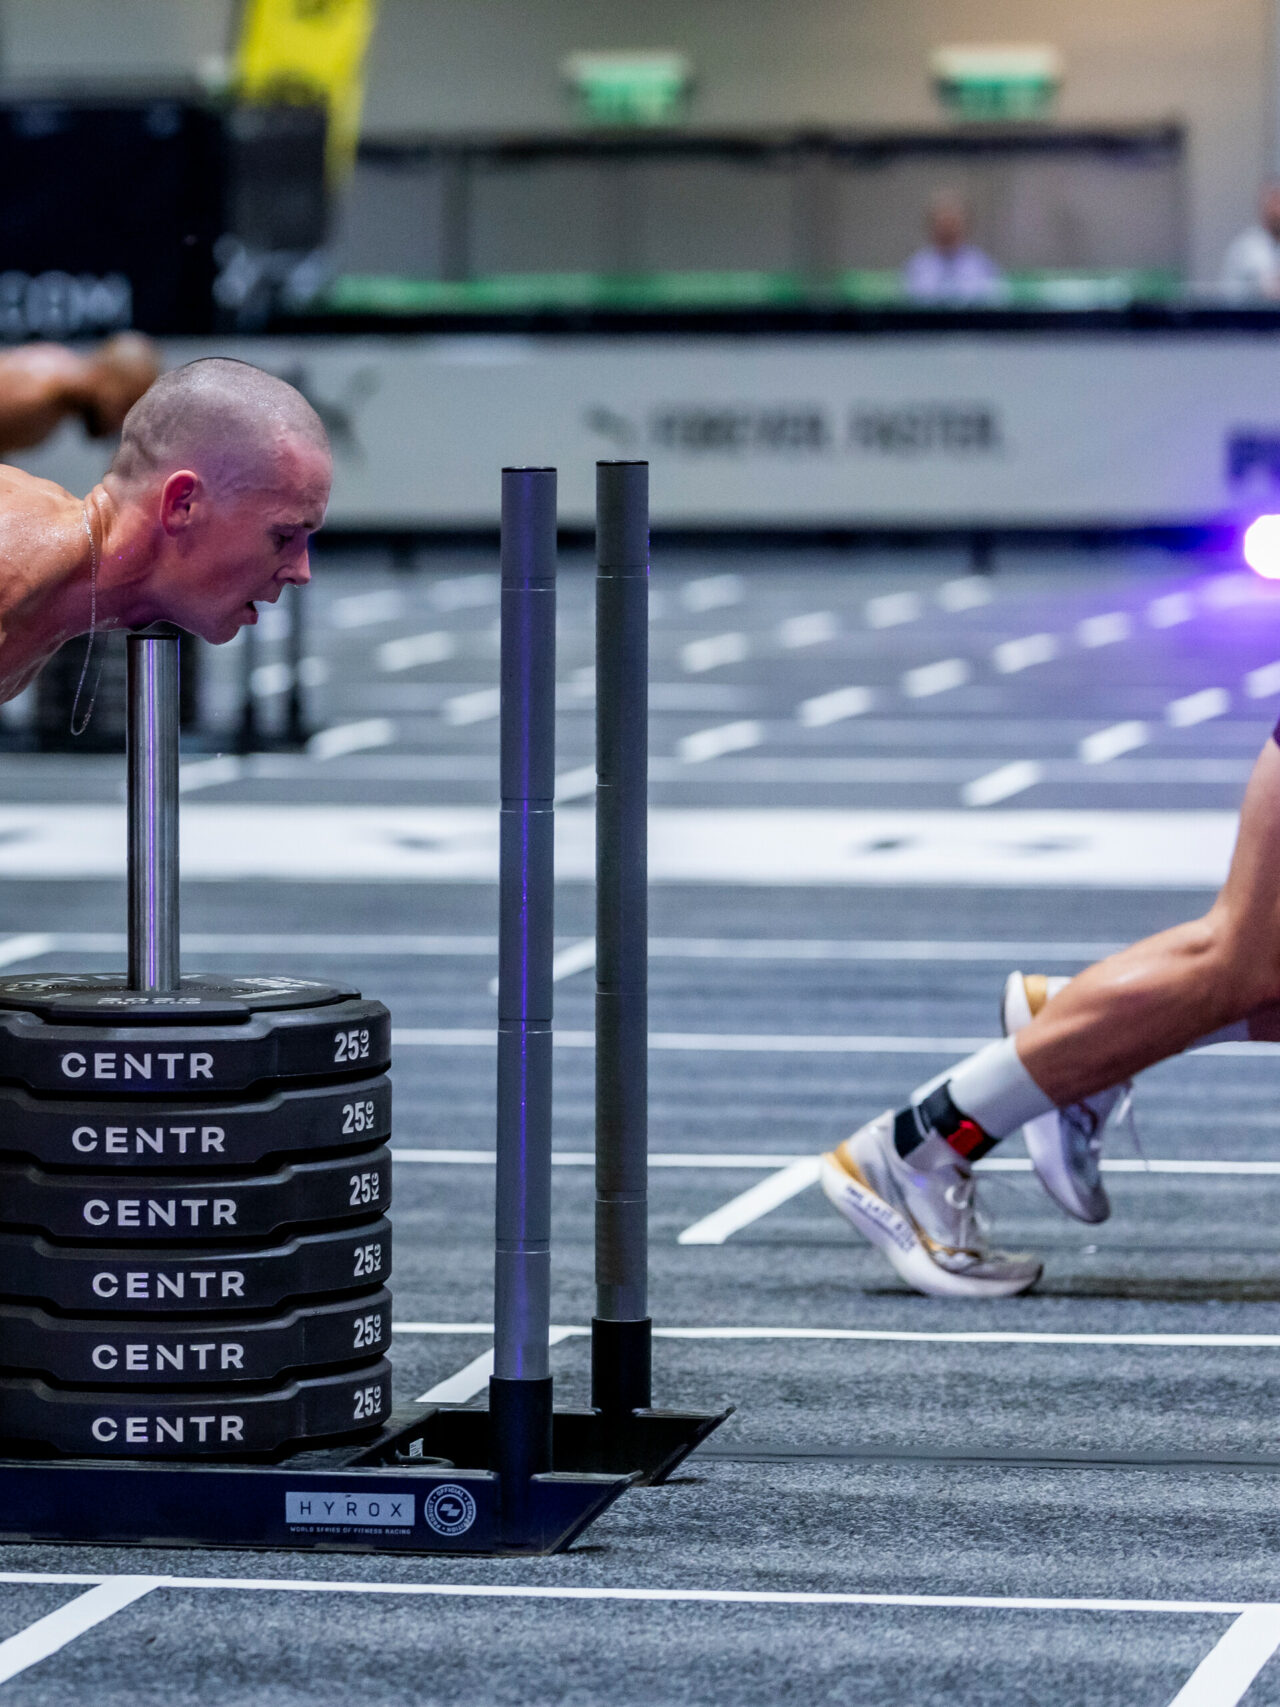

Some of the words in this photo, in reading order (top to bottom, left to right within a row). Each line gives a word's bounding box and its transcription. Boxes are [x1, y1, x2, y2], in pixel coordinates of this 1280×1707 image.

[62, 1052, 214, 1080] CENTR
[72, 1126, 225, 1153] CENTR
[83, 1199, 237, 1226] CENTR
[92, 1271, 245, 1298] CENTR
[92, 1343, 244, 1370] CENTR
[91, 1415, 244, 1442] CENTR
[300, 1501, 403, 1518] HYROX
[353, 1527, 382, 1535] FITNESS
[385, 1528, 411, 1536] RACING
